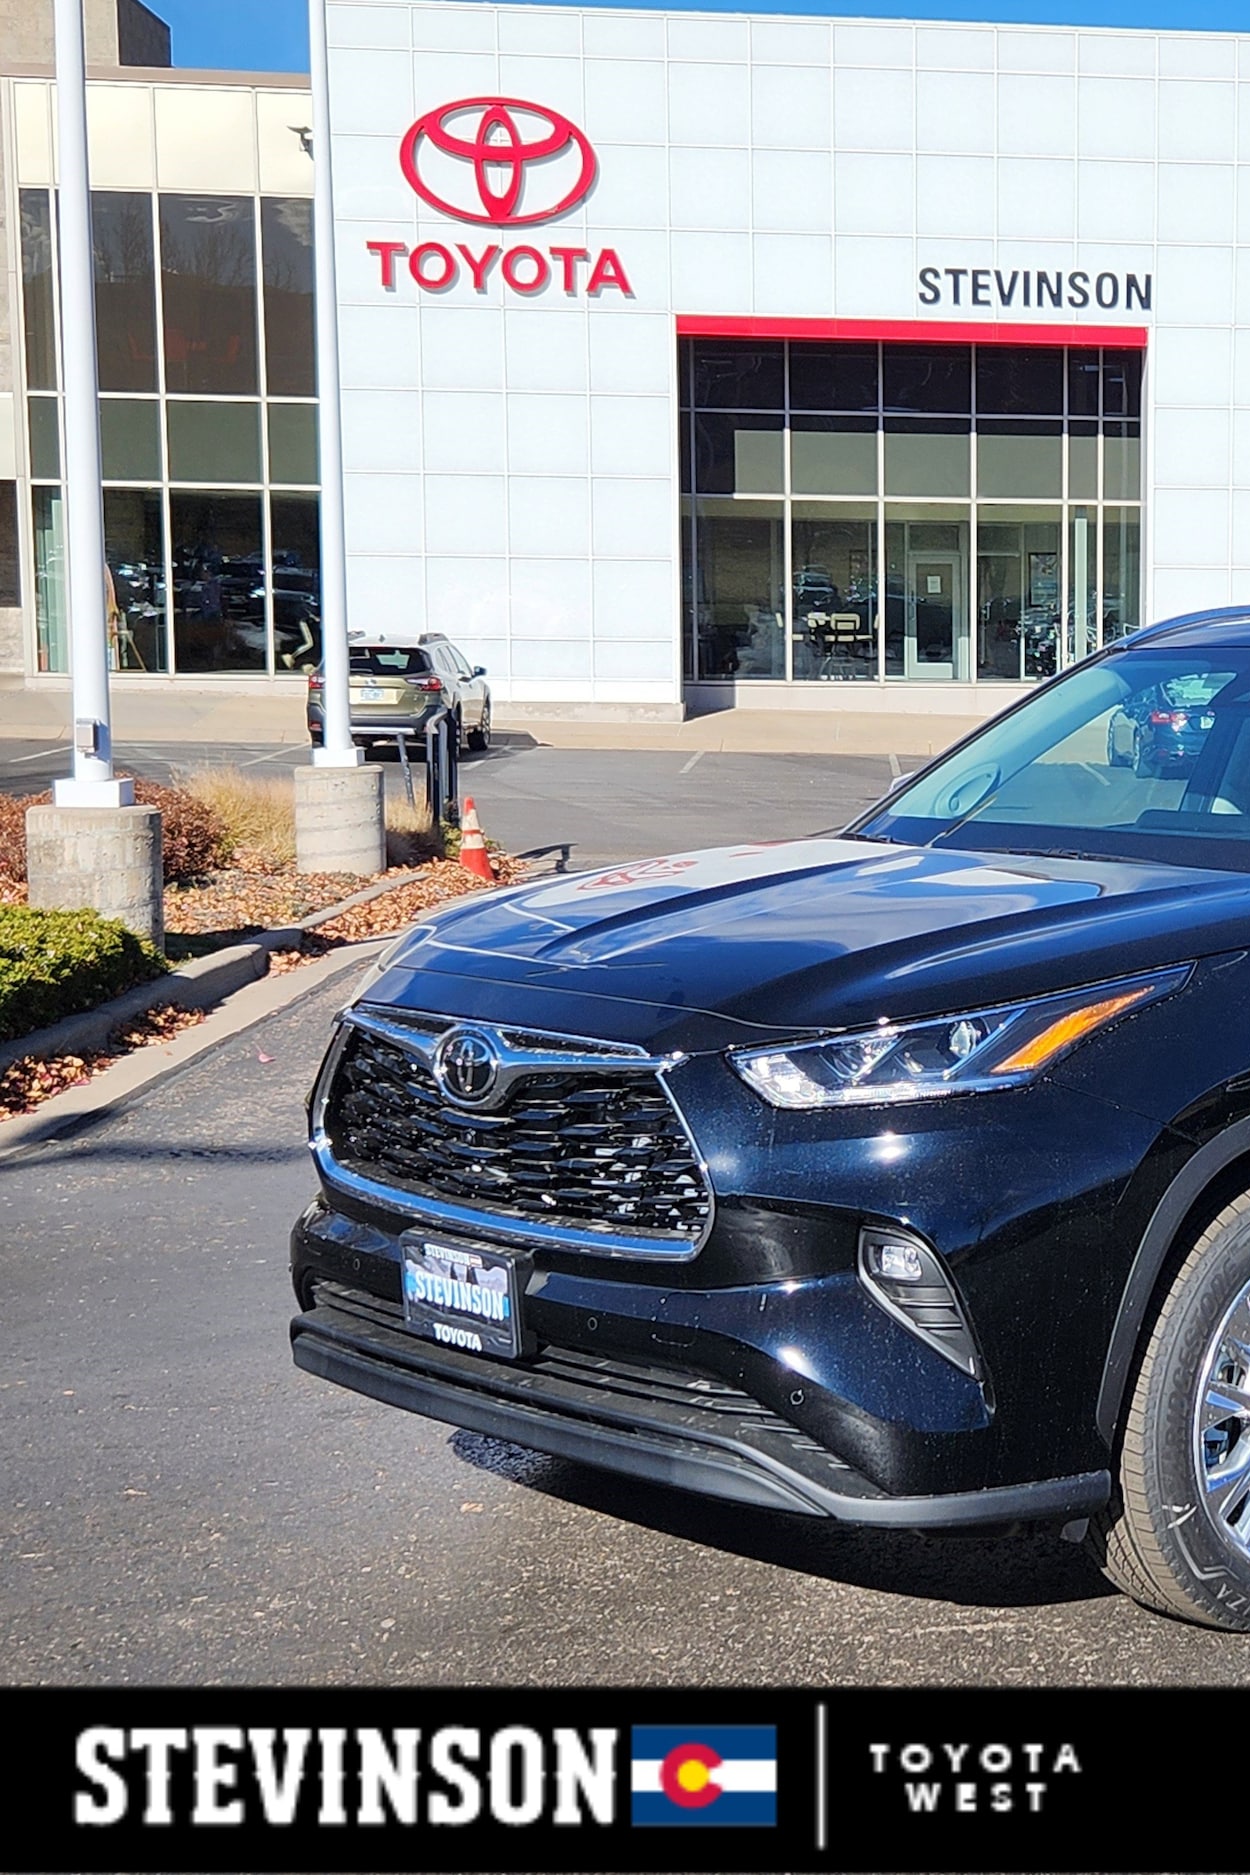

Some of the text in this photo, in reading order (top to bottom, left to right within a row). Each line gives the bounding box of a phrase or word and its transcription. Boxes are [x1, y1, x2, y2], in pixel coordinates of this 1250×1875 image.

[367, 241, 633, 297] TOYOTA
[919, 267, 1151, 310] STEVINSON
[414, 1270, 505, 1321] STEVINSON
[432, 1322, 482, 1351] TOYOTA
